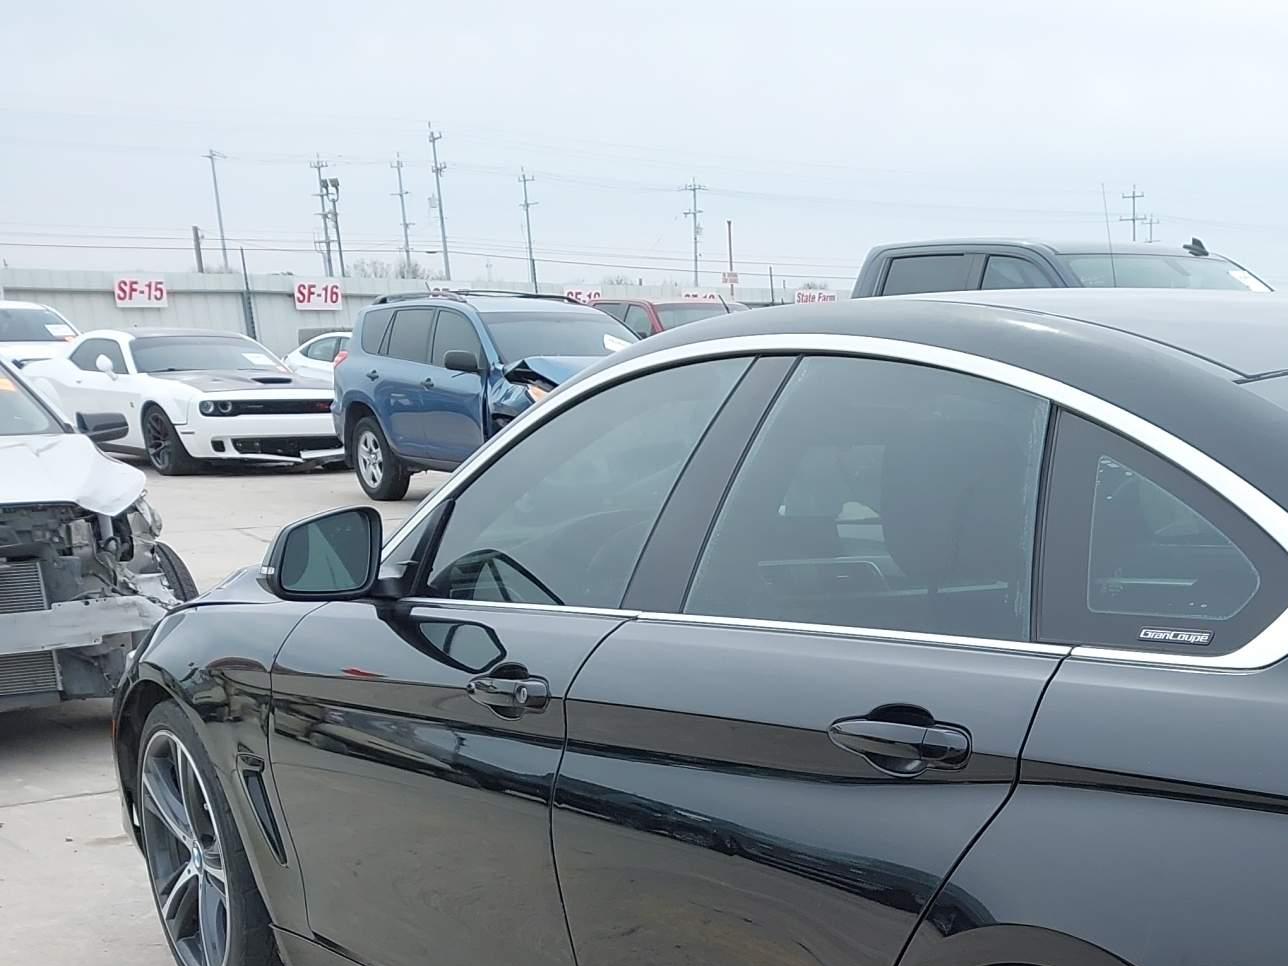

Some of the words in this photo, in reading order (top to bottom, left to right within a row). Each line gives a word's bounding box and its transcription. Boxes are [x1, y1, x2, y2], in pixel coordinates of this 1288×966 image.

[116, 279, 165, 301] SF-15
[296, 283, 340, 304] SF-16
[797, 292, 816, 303] State
[817, 292, 836, 302] Farm
